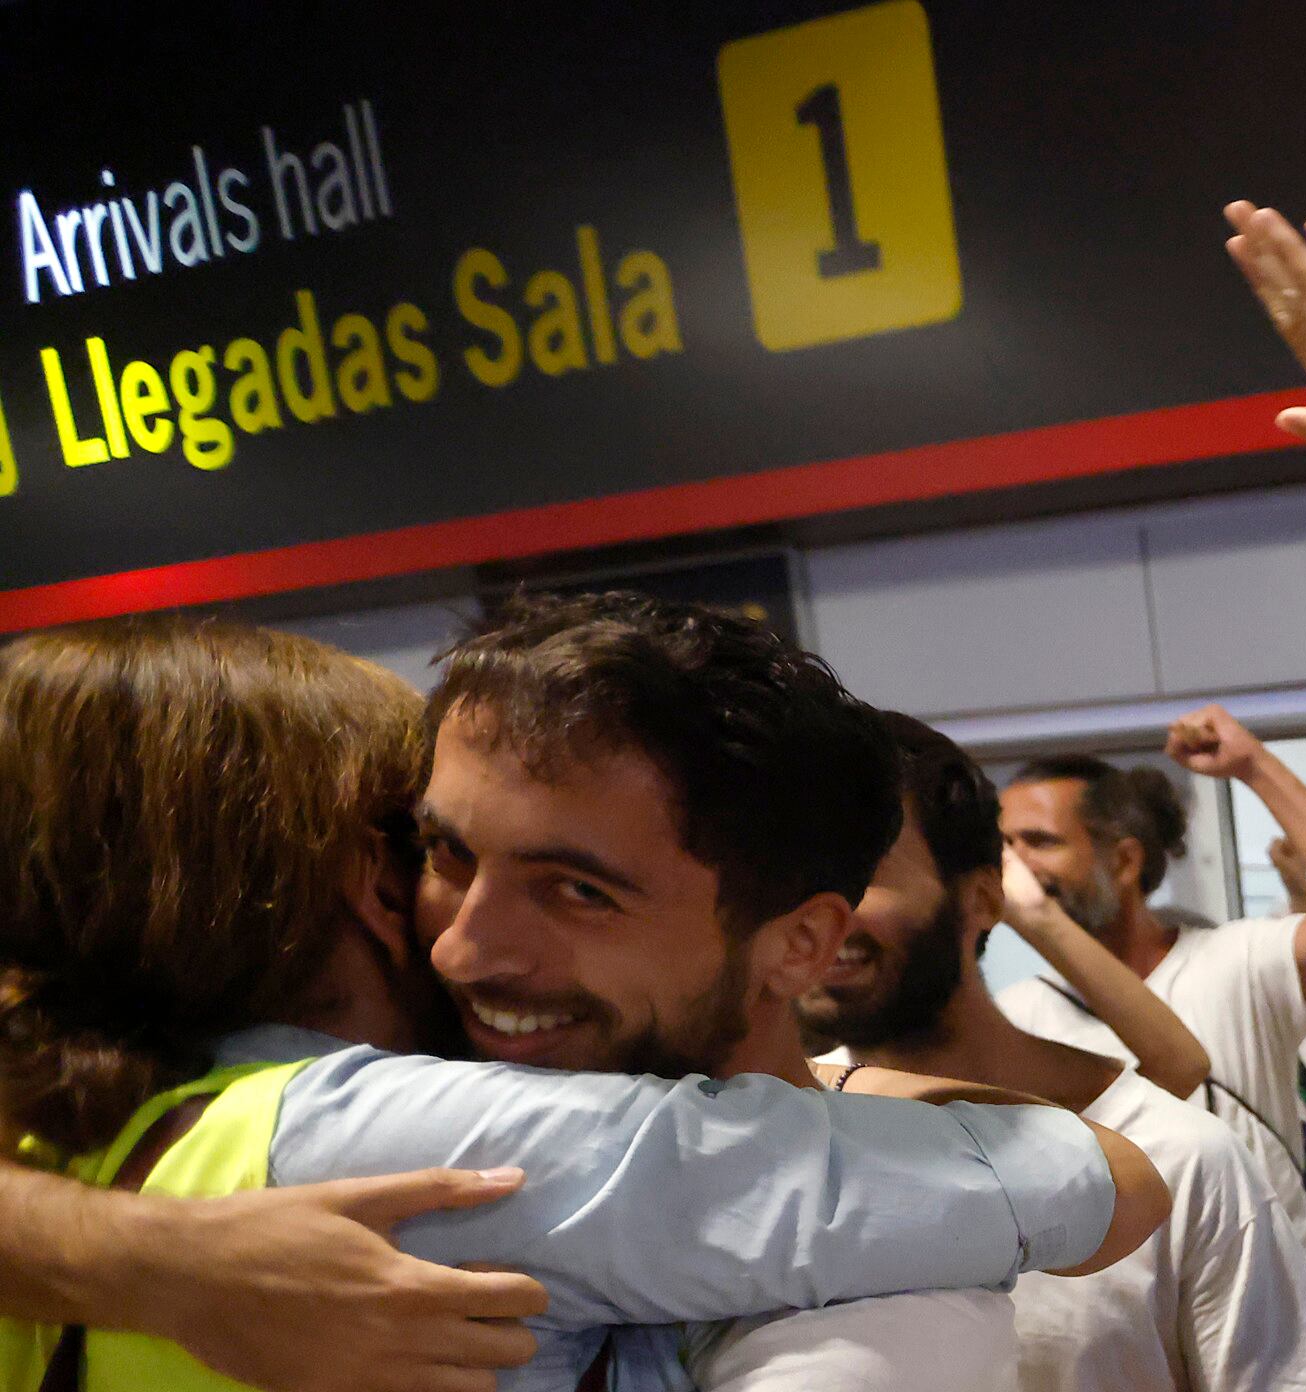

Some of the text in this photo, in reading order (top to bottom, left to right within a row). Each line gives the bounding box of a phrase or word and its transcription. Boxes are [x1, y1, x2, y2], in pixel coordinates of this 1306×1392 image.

[17, 99, 393, 305] Arrivals hall
[40, 82, 882, 472] Llegadas Sala 1
